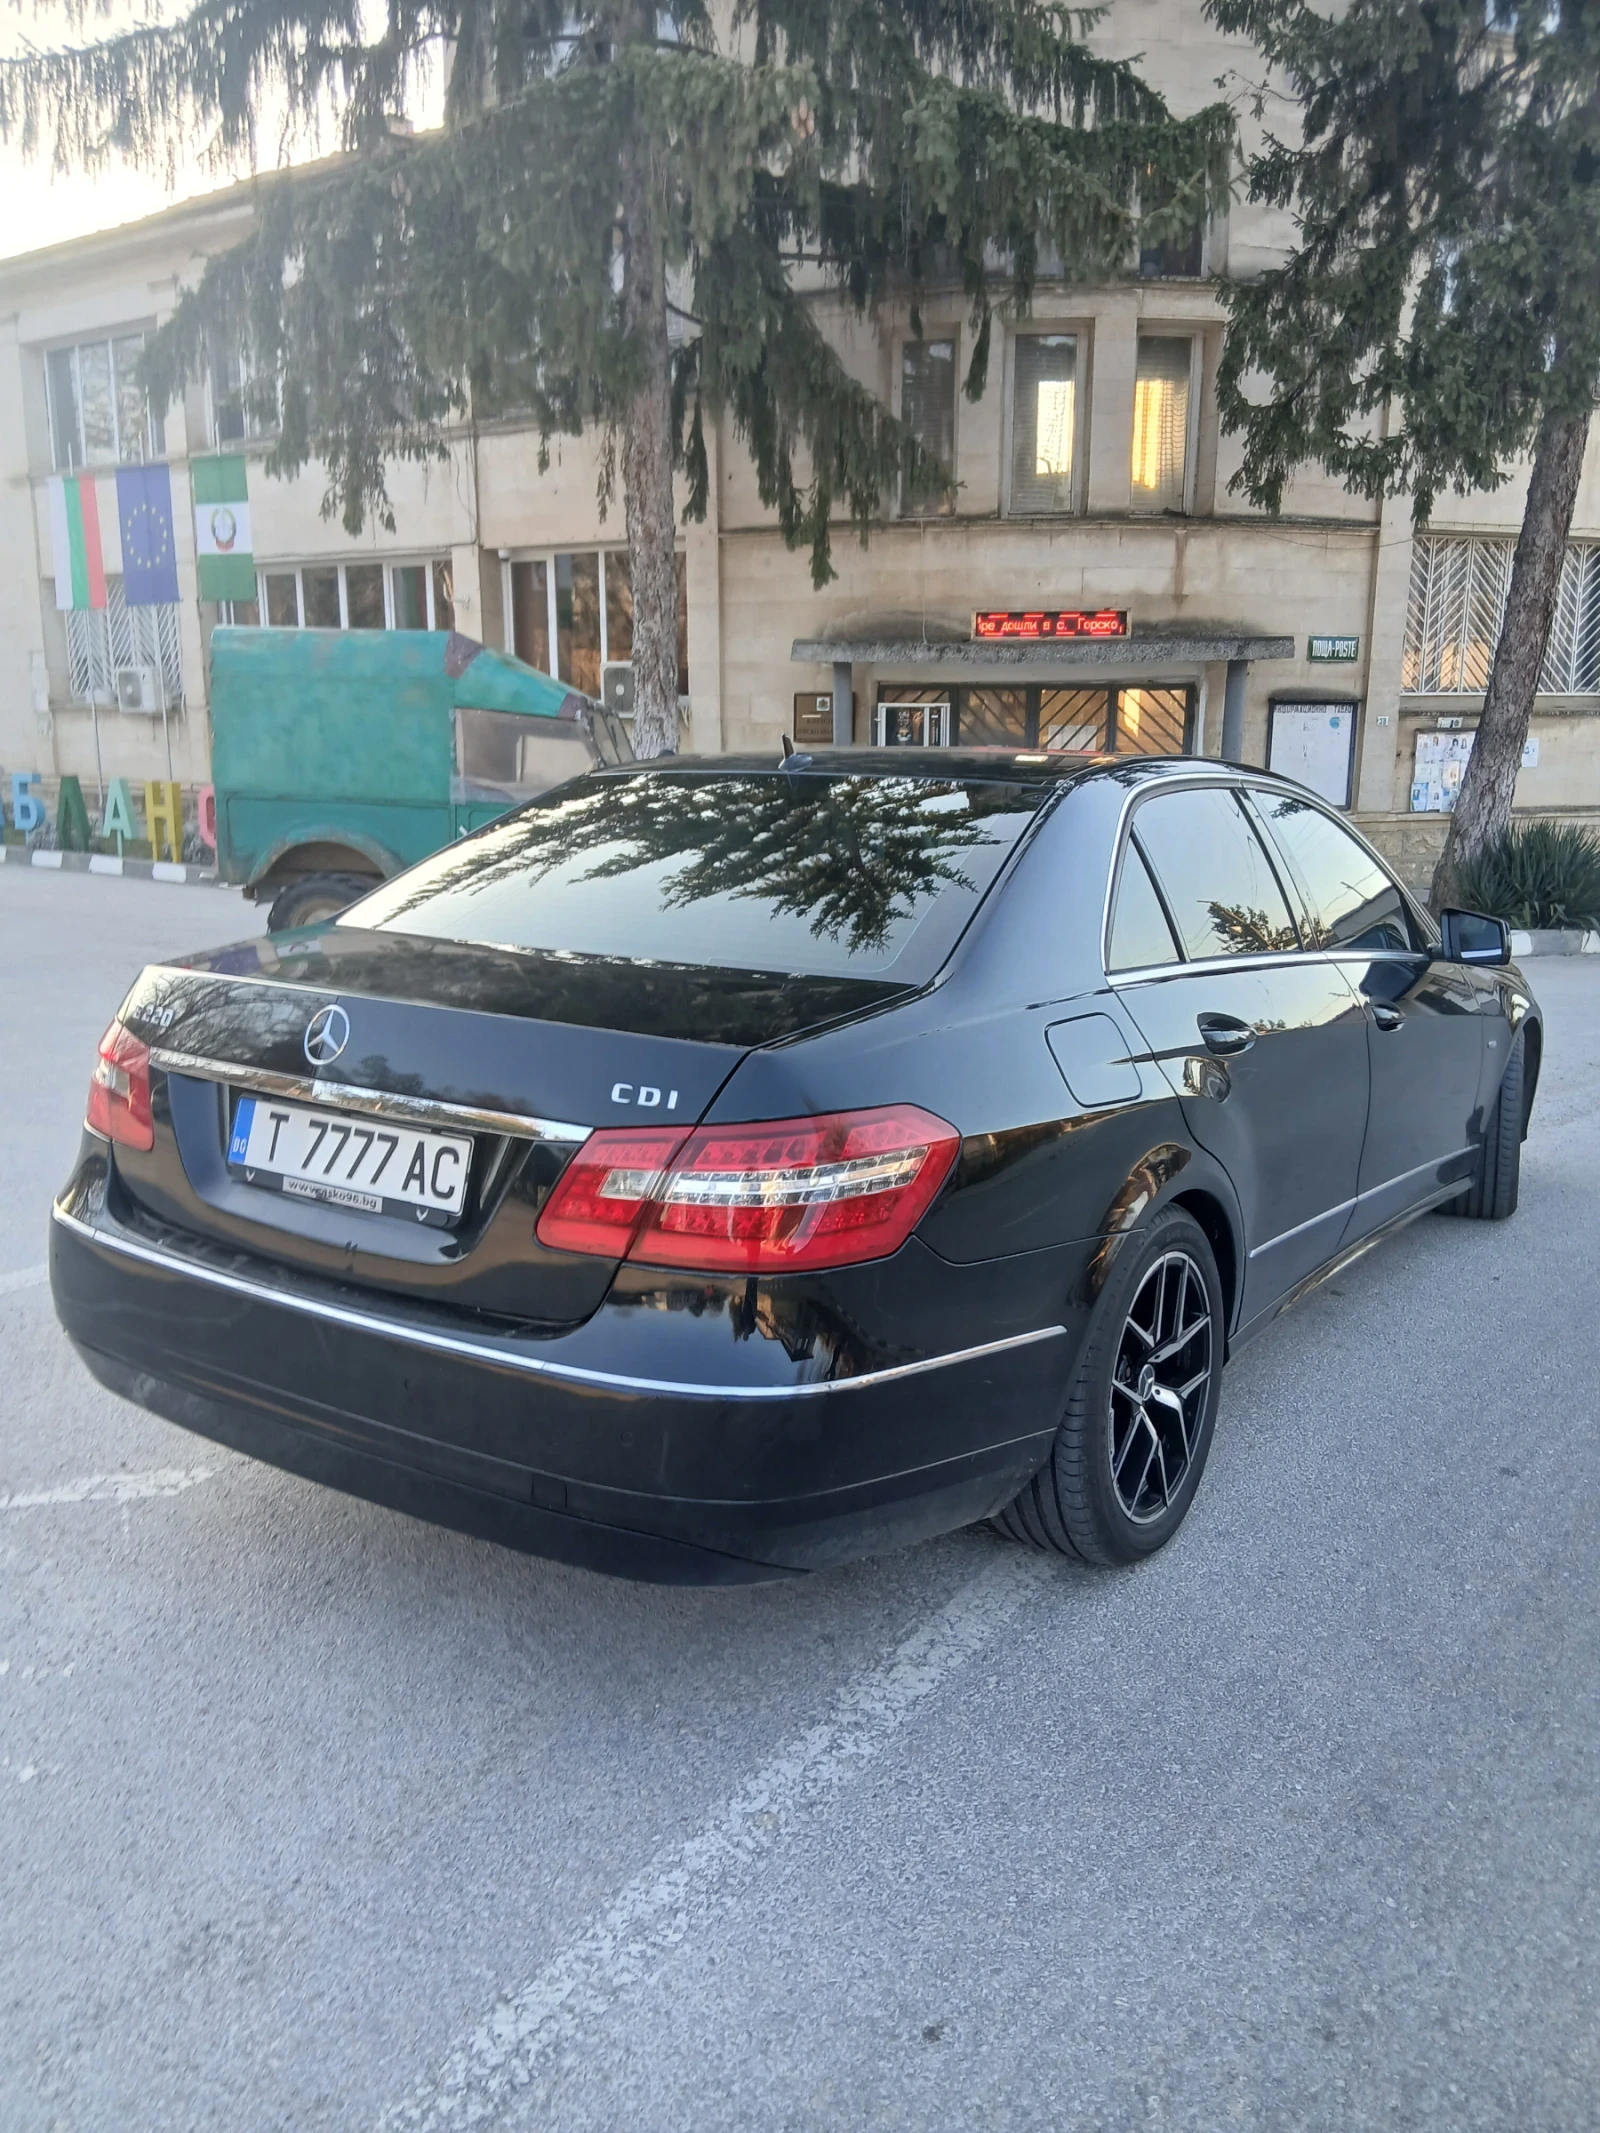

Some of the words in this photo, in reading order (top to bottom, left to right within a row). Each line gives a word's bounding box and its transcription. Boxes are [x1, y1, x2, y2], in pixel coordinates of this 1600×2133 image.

[1001, 620, 1037, 632] дошли
[1043, 621, 1050, 631] в
[1056, 621, 1068, 631] с.
[0, 773, 217, 851] БЛАН
[611, 1082, 678, 1110] CDI
[301, 1118, 399, 1185] 7777
[401, 1140, 460, 1200] AC
